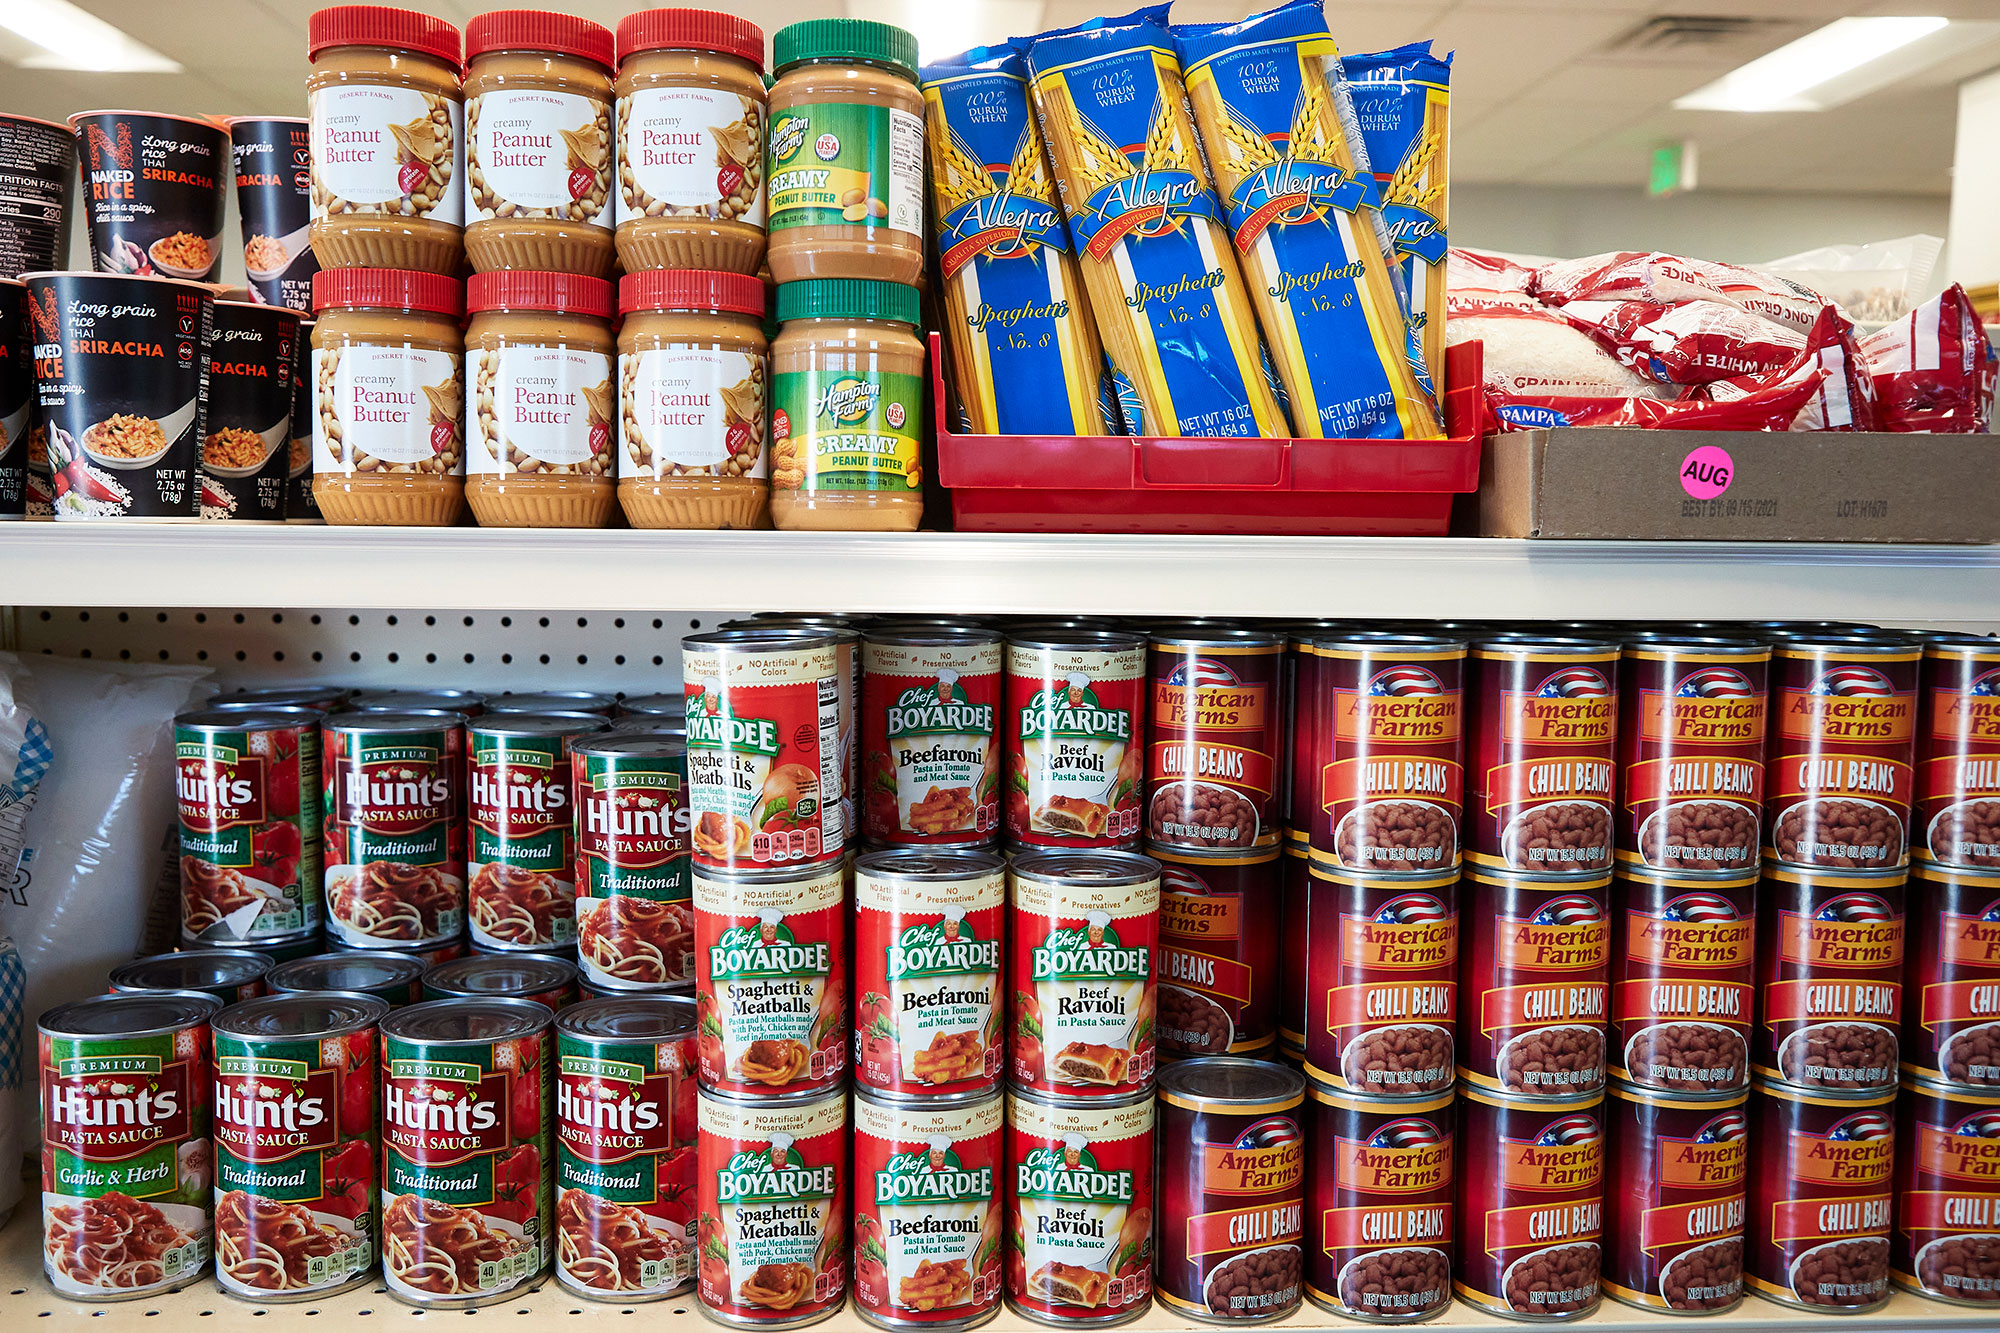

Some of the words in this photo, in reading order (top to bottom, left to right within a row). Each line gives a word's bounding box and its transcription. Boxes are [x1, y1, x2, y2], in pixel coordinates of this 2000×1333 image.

[1217, 51, 1250, 67] IMPORTED
[1253, 48, 1270, 58] MADE
[1238, 61, 1278, 78] 100%
[1092, 69, 1133, 90] 100%
[1241, 76, 1280, 88] DURUM
[1096, 84, 1136, 101] DURUM
[1244, 84, 1280, 95] WHEAT
[1099, 93, 1136, 108] WHEAT
[969, 106, 1008, 117] DURUM
[970, 113, 1007, 123] WHEAT
[326, 114, 361, 127] creamy
[493, 118, 532, 130] creamy
[643, 115, 682, 128] creamy
[325, 128, 382, 145] Peanut
[492, 131, 553, 148] Peanut
[642, 129, 702, 147] Peanut
[141, 135, 178, 150] Long
[178, 143, 211, 157] grain
[141, 149, 167, 159] rice
[817, 142, 838, 152] USA
[142, 158, 166, 168] THAI
[325, 147, 375, 164] Butter
[492, 151, 547, 168] Butter
[642, 149, 696, 167] Butter
[91, 170, 135, 184] NAKED
[142, 168, 214, 190] SRIRACHA
[40, 181, 64, 192] FACTS
[93, 182, 135, 200] RICE
[1242, 156, 1347, 222] Allegra
[774, 194, 799, 207] PEANUT
[802, 192, 836, 203] BUTTER
[1099, 167, 1202, 234] Allegra
[43, 207, 61, 220] 290
[1125, 268, 1225, 312] Spaghetti
[1268, 260, 1366, 303] Spaghetti
[68, 300, 109, 317] Long
[112, 304, 157, 318] grain
[1301, 298, 1336, 317] No.
[1341, 292, 1353, 308] 8
[68, 316, 96, 328] rice
[967, 300, 1069, 332] Spaghetti
[1159, 306, 1194, 327] No.
[1199, 303, 1211, 318] 8
[69, 329, 94, 338] THAI
[70, 340, 164, 358] SRIRACHA
[354, 374, 396, 388] creamy
[353, 387, 416, 405] Peanut
[815, 380, 880, 417] Hampton
[353, 406, 411, 424] Butter
[833, 397, 877, 428] Farms
[887, 408, 904, 420] USA
[1319, 406, 1342, 422] NET
[1343, 400, 1362, 418] WT
[1363, 396, 1376, 412] 16
[1377, 391, 1394, 407] OZ
[1178, 416, 1201, 432] NET
[1202, 412, 1220, 426] WT
[1222, 409, 1234, 422] 16
[1236, 404, 1251, 419] OZ
[1332, 415, 1360, 435] (1LB)
[1361, 411, 1378, 427] 454
[1379, 411, 1387, 425] g
[1501, 408, 1556, 426] PAMPA
[814, 434, 898, 456] CREAMY
[832, 456, 869, 466] PEANUT
[872, 456, 903, 470] BUTTER
[156, 470, 173, 480] NET
[174, 470, 186, 480] WT
[1683, 460, 1729, 487] AUG
[157, 480, 175, 491] 2.75
[176, 482, 185, 491] oz
[161, 491, 182, 504] (78g)
[1681, 500, 1707, 517] BEST
[1709, 500, 1725, 517] BY:
[1836, 500, 1858, 517] LOT:
[922, 659, 968, 667] Preservatives
[940, 652, 951, 660] NO
[898, 688, 934, 706] Chef
[887, 704, 994, 736] BOYARDEE
[913, 763, 933, 773] Pasta
[934, 763, 943, 772] in
[944, 763, 970, 772] Tomato
[603, 776, 668, 786] PREMIUM
[913, 774, 928, 783] and
[929, 773, 948, 782] Meat
[950, 772, 970, 781] Sauce
[1528, 763, 1570, 794] CHILI
[1575, 763, 1610, 793] BEANS
[595, 839, 633, 852] PASTA
[636, 837, 682, 852] SAUCE
[753, 838, 769, 849] 410
[600, 873, 680, 889] Traditional
[1072, 900, 1121, 910] Preservatives
[720, 926, 756, 949] Chef
[1641, 922, 1750, 943] American
[1662, 942, 1738, 961] Farms
[711, 944, 829, 977] BOYARDEE
[727, 981, 801, 1002] Spaghetti
[804, 984, 814, 996] &
[732, 998, 811, 1016] Meatballs
[1651, 985, 1692, 1013] CHILI
[1697, 985, 1740, 1016] BEANS
[728, 1017, 745, 1026] Pasta
[746, 1016, 759, 1024] and
[761, 1015, 795, 1024] Meatballs
[732, 1025, 747, 1033] with
[748, 1024, 765, 1033] Pork,
[767, 1023, 796, 1032] Chicken
[798, 1023, 810, 1031] and
[70, 1060, 146, 1071] PREMIUM
[226, 1062, 293, 1074] PREMIUM
[399, 1065, 467, 1078] PREMIUM
[61, 1129, 105, 1145] PASTA
[108, 1126, 163, 1144] SAUCE
[220, 1130, 255, 1145] PASTA
[256, 1133, 309, 1145] SAUCE
[392, 1129, 426, 1147] PASTA
[429, 1136, 481, 1149] SAUCE
[1026, 1151, 1060, 1170] Chef
[1353, 1146, 1450, 1168] American
[60, 1168, 104, 1186] Garlic
[107, 1170, 121, 1185] &
[127, 1162, 169, 1184] Herb
[223, 1164, 305, 1187] Traditional
[394, 1168, 478, 1191] Traditional
[1372, 1167, 1441, 1186] Farms
[1019, 1167, 1132, 1200] BOYARDEE
[1056, 1208, 1086, 1221] Beef
[1818, 1202, 1860, 1231] CHILI
[1037, 1216, 1104, 1239] Ravioli
[1362, 1211, 1402, 1240] CHILI
[1407, 1209, 1443, 1237] BEANS
[1037, 1237, 1046, 1245] in
[1048, 1237, 1074, 1247] Pasta
[1076, 1239, 1105, 1249] Sauce
[167, 1252, 178, 1265] 35
[311, 1261, 323, 1272] 40
[1109, 1284, 1122, 1295] 320
